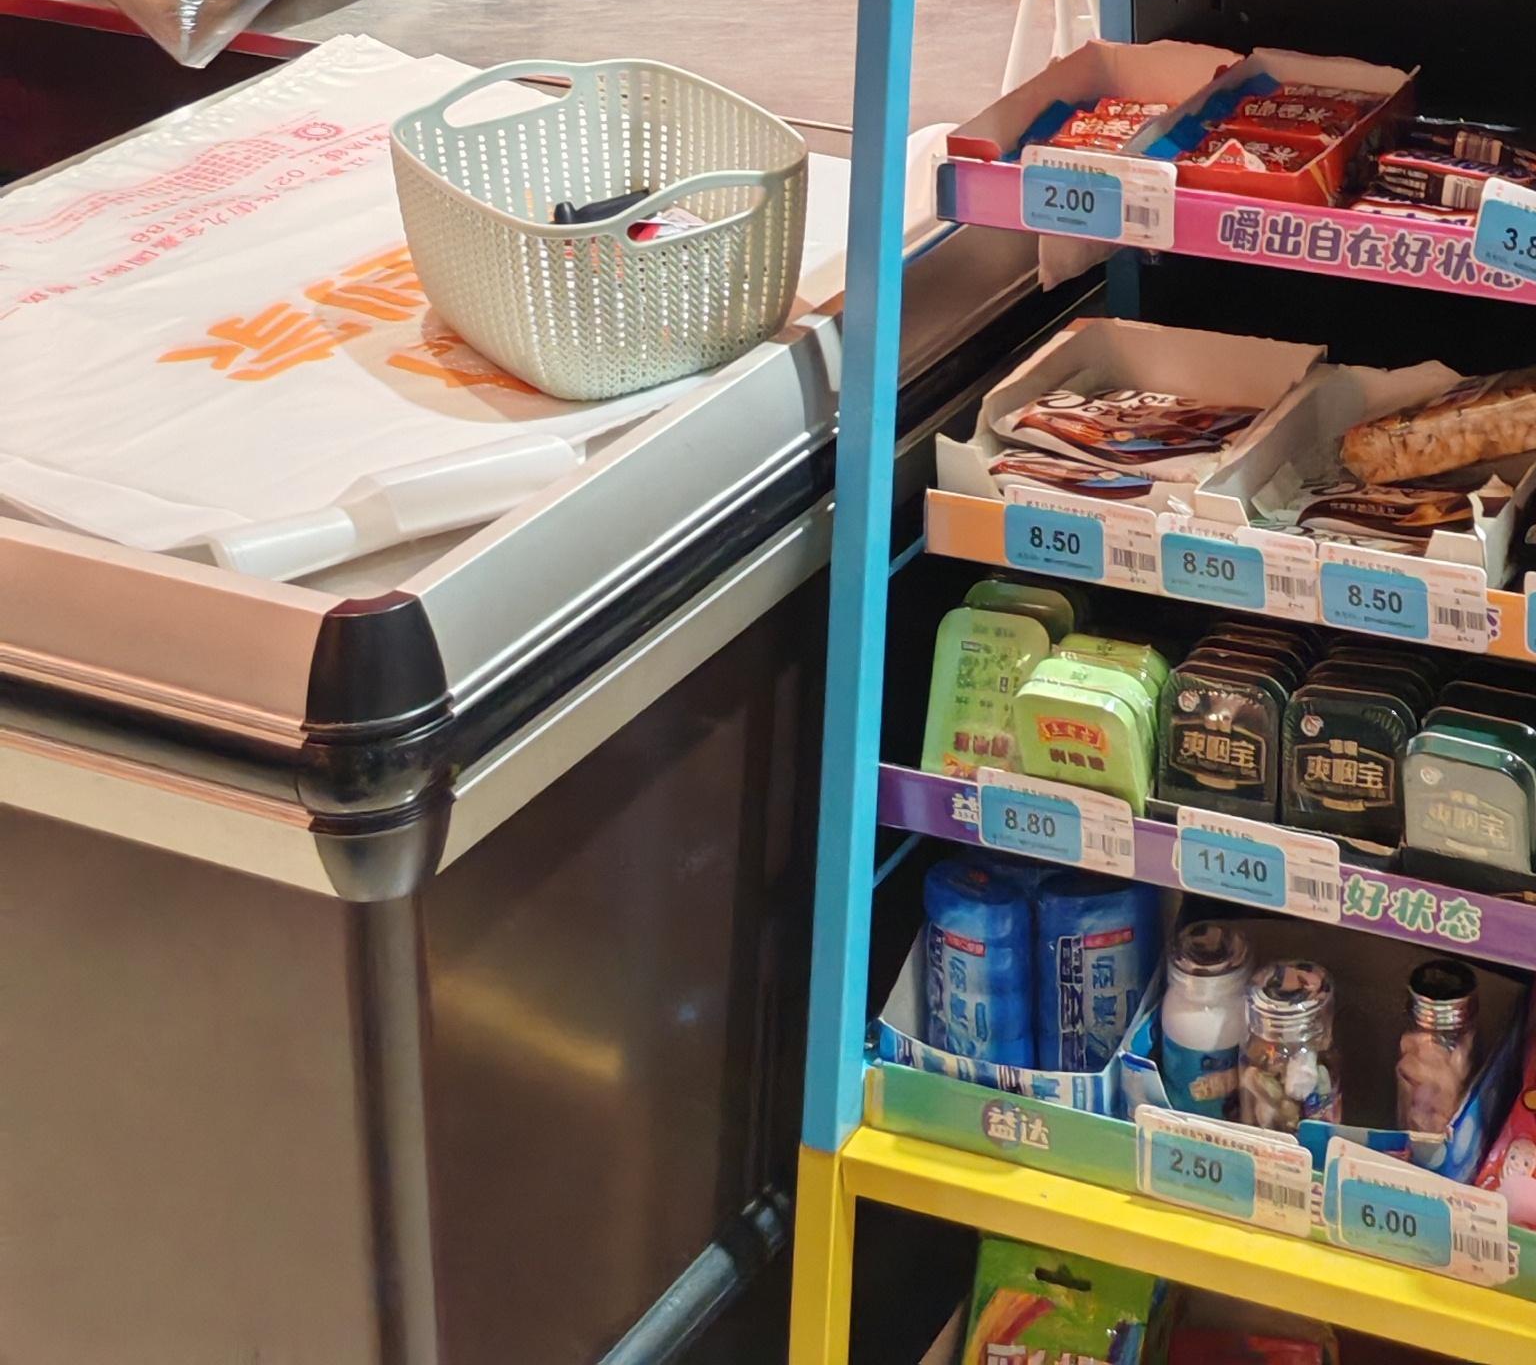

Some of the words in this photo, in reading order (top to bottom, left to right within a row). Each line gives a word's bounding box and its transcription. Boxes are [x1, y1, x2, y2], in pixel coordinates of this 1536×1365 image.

[1043, 184, 1096, 214] 2.00
[1029, 525, 1081, 556] 8.50
[1182, 551, 1236, 581] 8.50
[1347, 584, 1404, 614] 8.50
[1004, 807, 1056, 839] 8.80
[1197, 849, 1268, 884] 11.40
[1169, 1147, 1224, 1185] 2.50
[1360, 1204, 1418, 1239] 6.00
